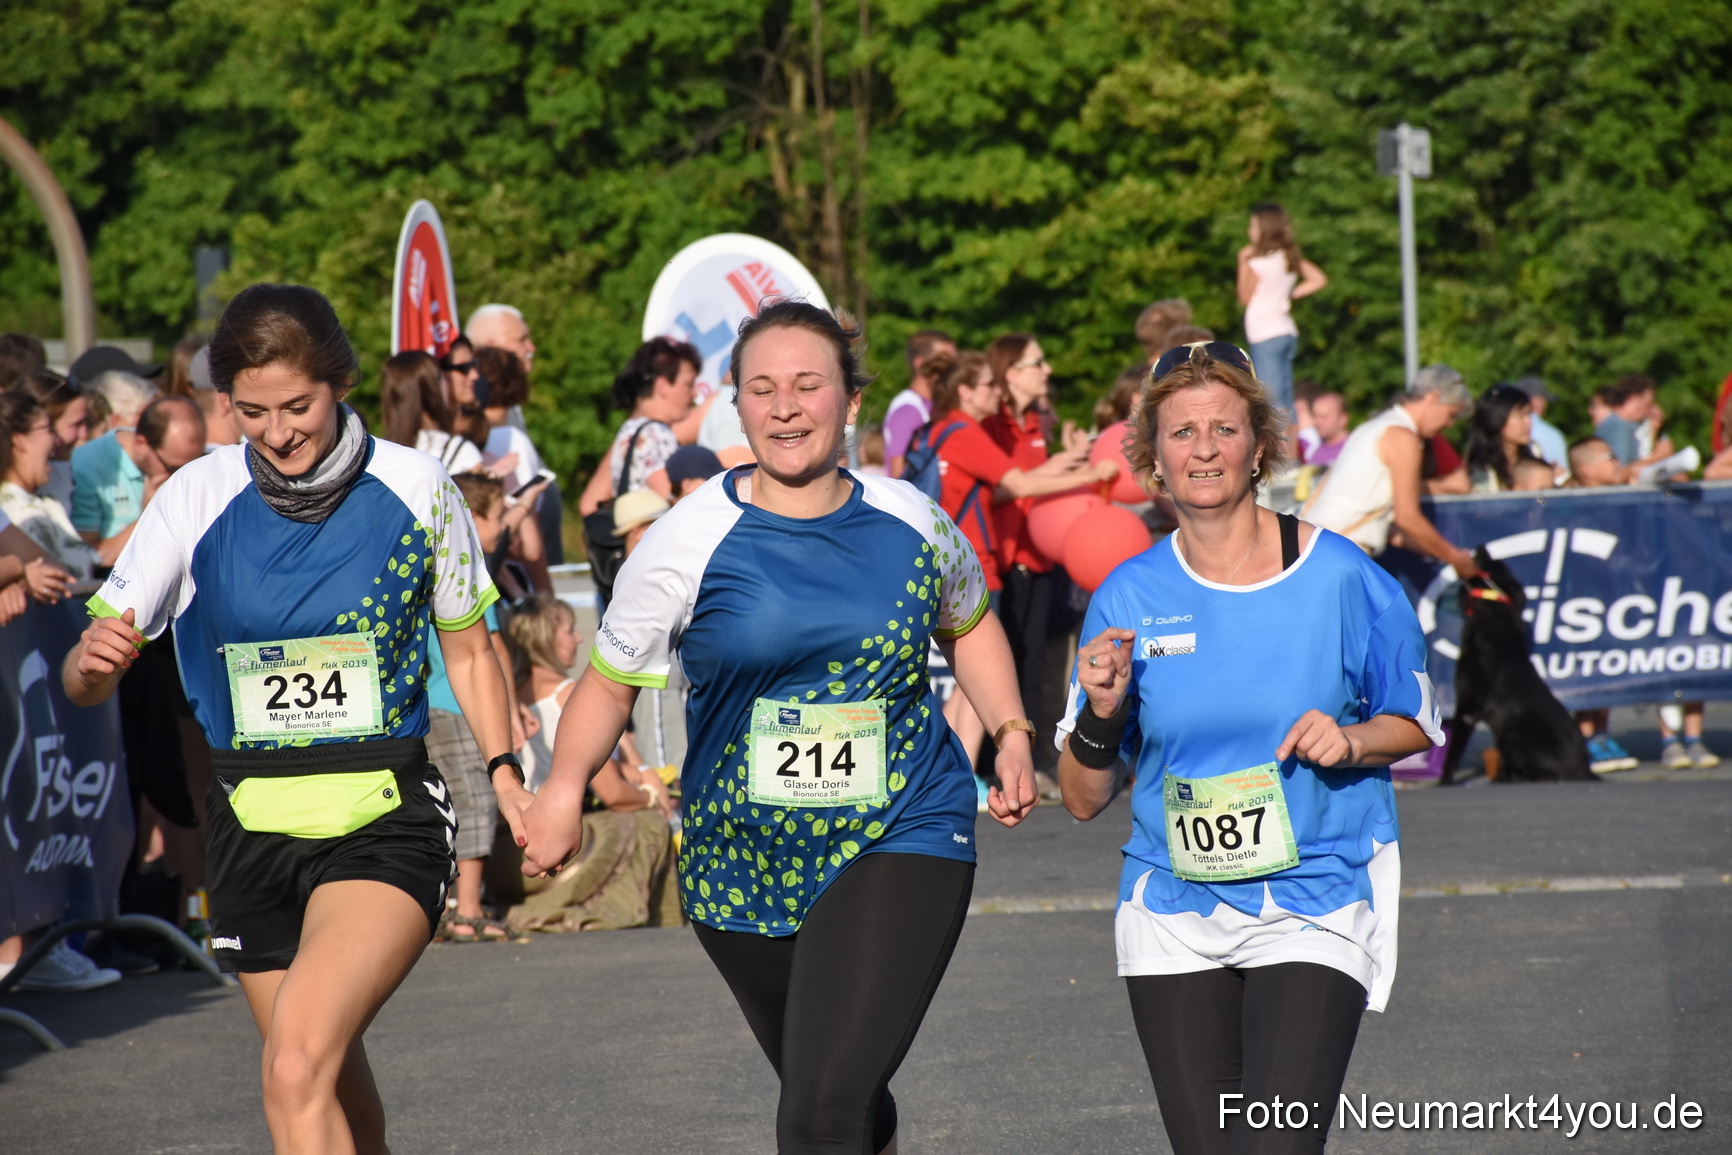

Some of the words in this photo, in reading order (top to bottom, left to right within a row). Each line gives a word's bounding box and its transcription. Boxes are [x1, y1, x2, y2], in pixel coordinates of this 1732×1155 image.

[250, 656, 308, 671] firmenlauf
[342, 659, 368, 669] 2019
[263, 670, 347, 711] 234
[269, 712, 301, 724] Mayer
[305, 710, 348, 721] Marlene
[285, 721, 320, 730] Bionorica
[322, 720, 333, 728] SE
[768, 721, 823, 735] firmenlauf
[854, 728, 878, 739] 2019
[776, 740, 856, 778] 214
[783, 779, 819, 790] Glaser
[822, 779, 850, 790] Doris
[793, 790, 828, 798] Bionorica
[1248, 793, 1274, 807] 2019
[1175, 806, 1266, 853] 1087
[1192, 853, 1224, 864] Töttels
[1226, 850, 1258, 862] Dietle
[1205, 864, 1218, 872] IKK
[1219, 863, 1245, 871] classic
